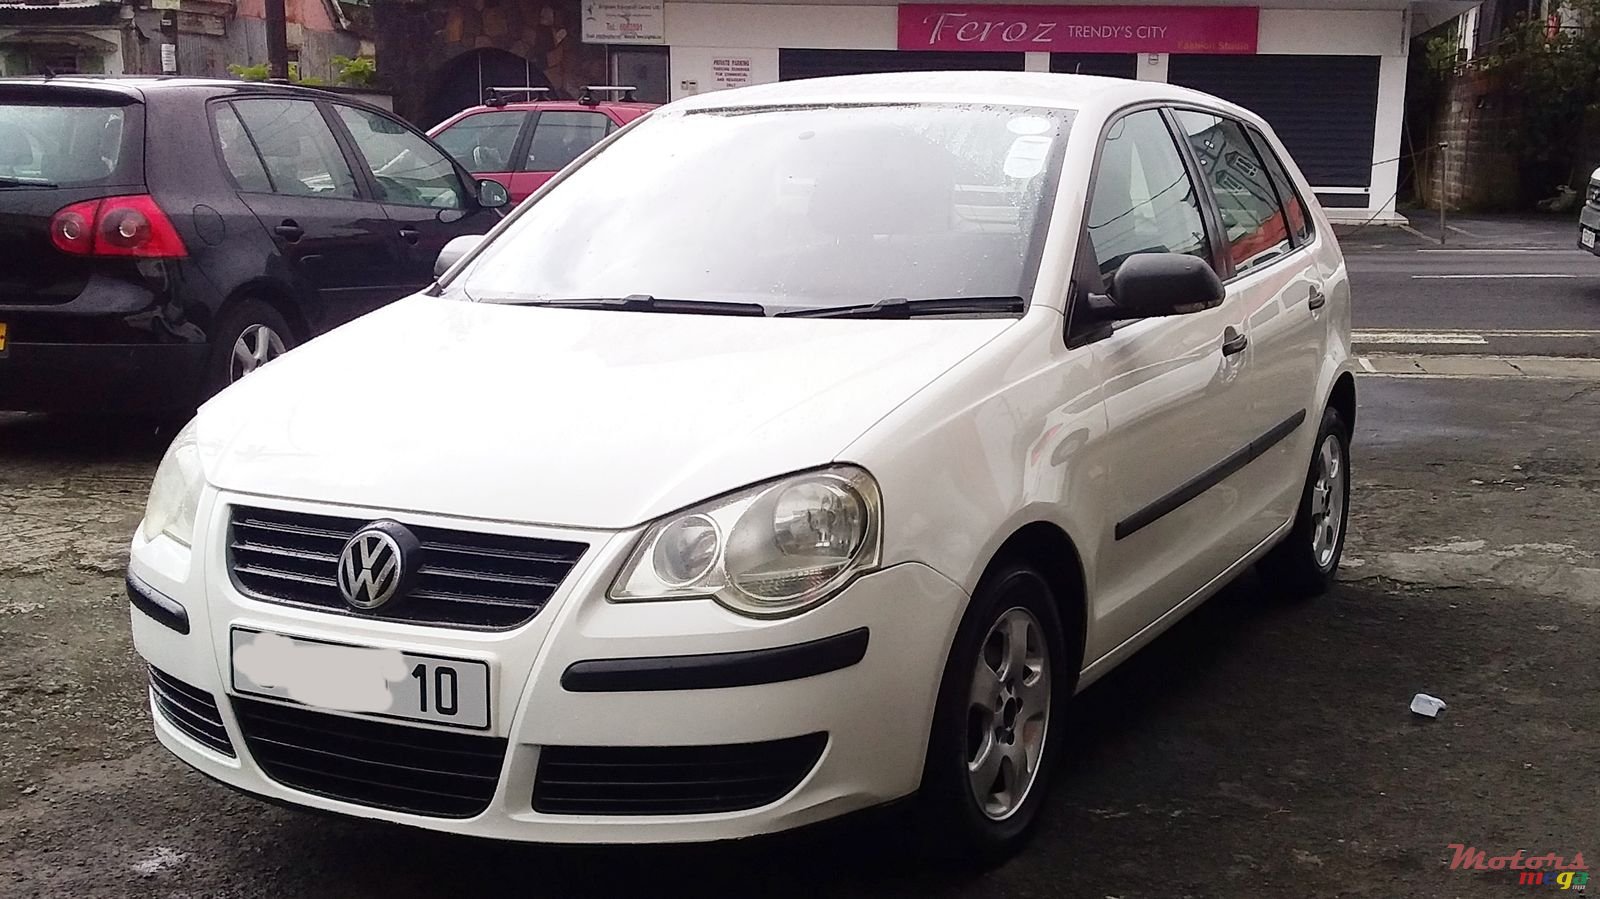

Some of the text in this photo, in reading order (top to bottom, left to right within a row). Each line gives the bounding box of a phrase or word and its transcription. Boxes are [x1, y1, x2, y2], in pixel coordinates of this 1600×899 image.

[923, 13, 1167, 45] Feroz TRENDY'S CITY
[411, 663, 458, 716] 10
